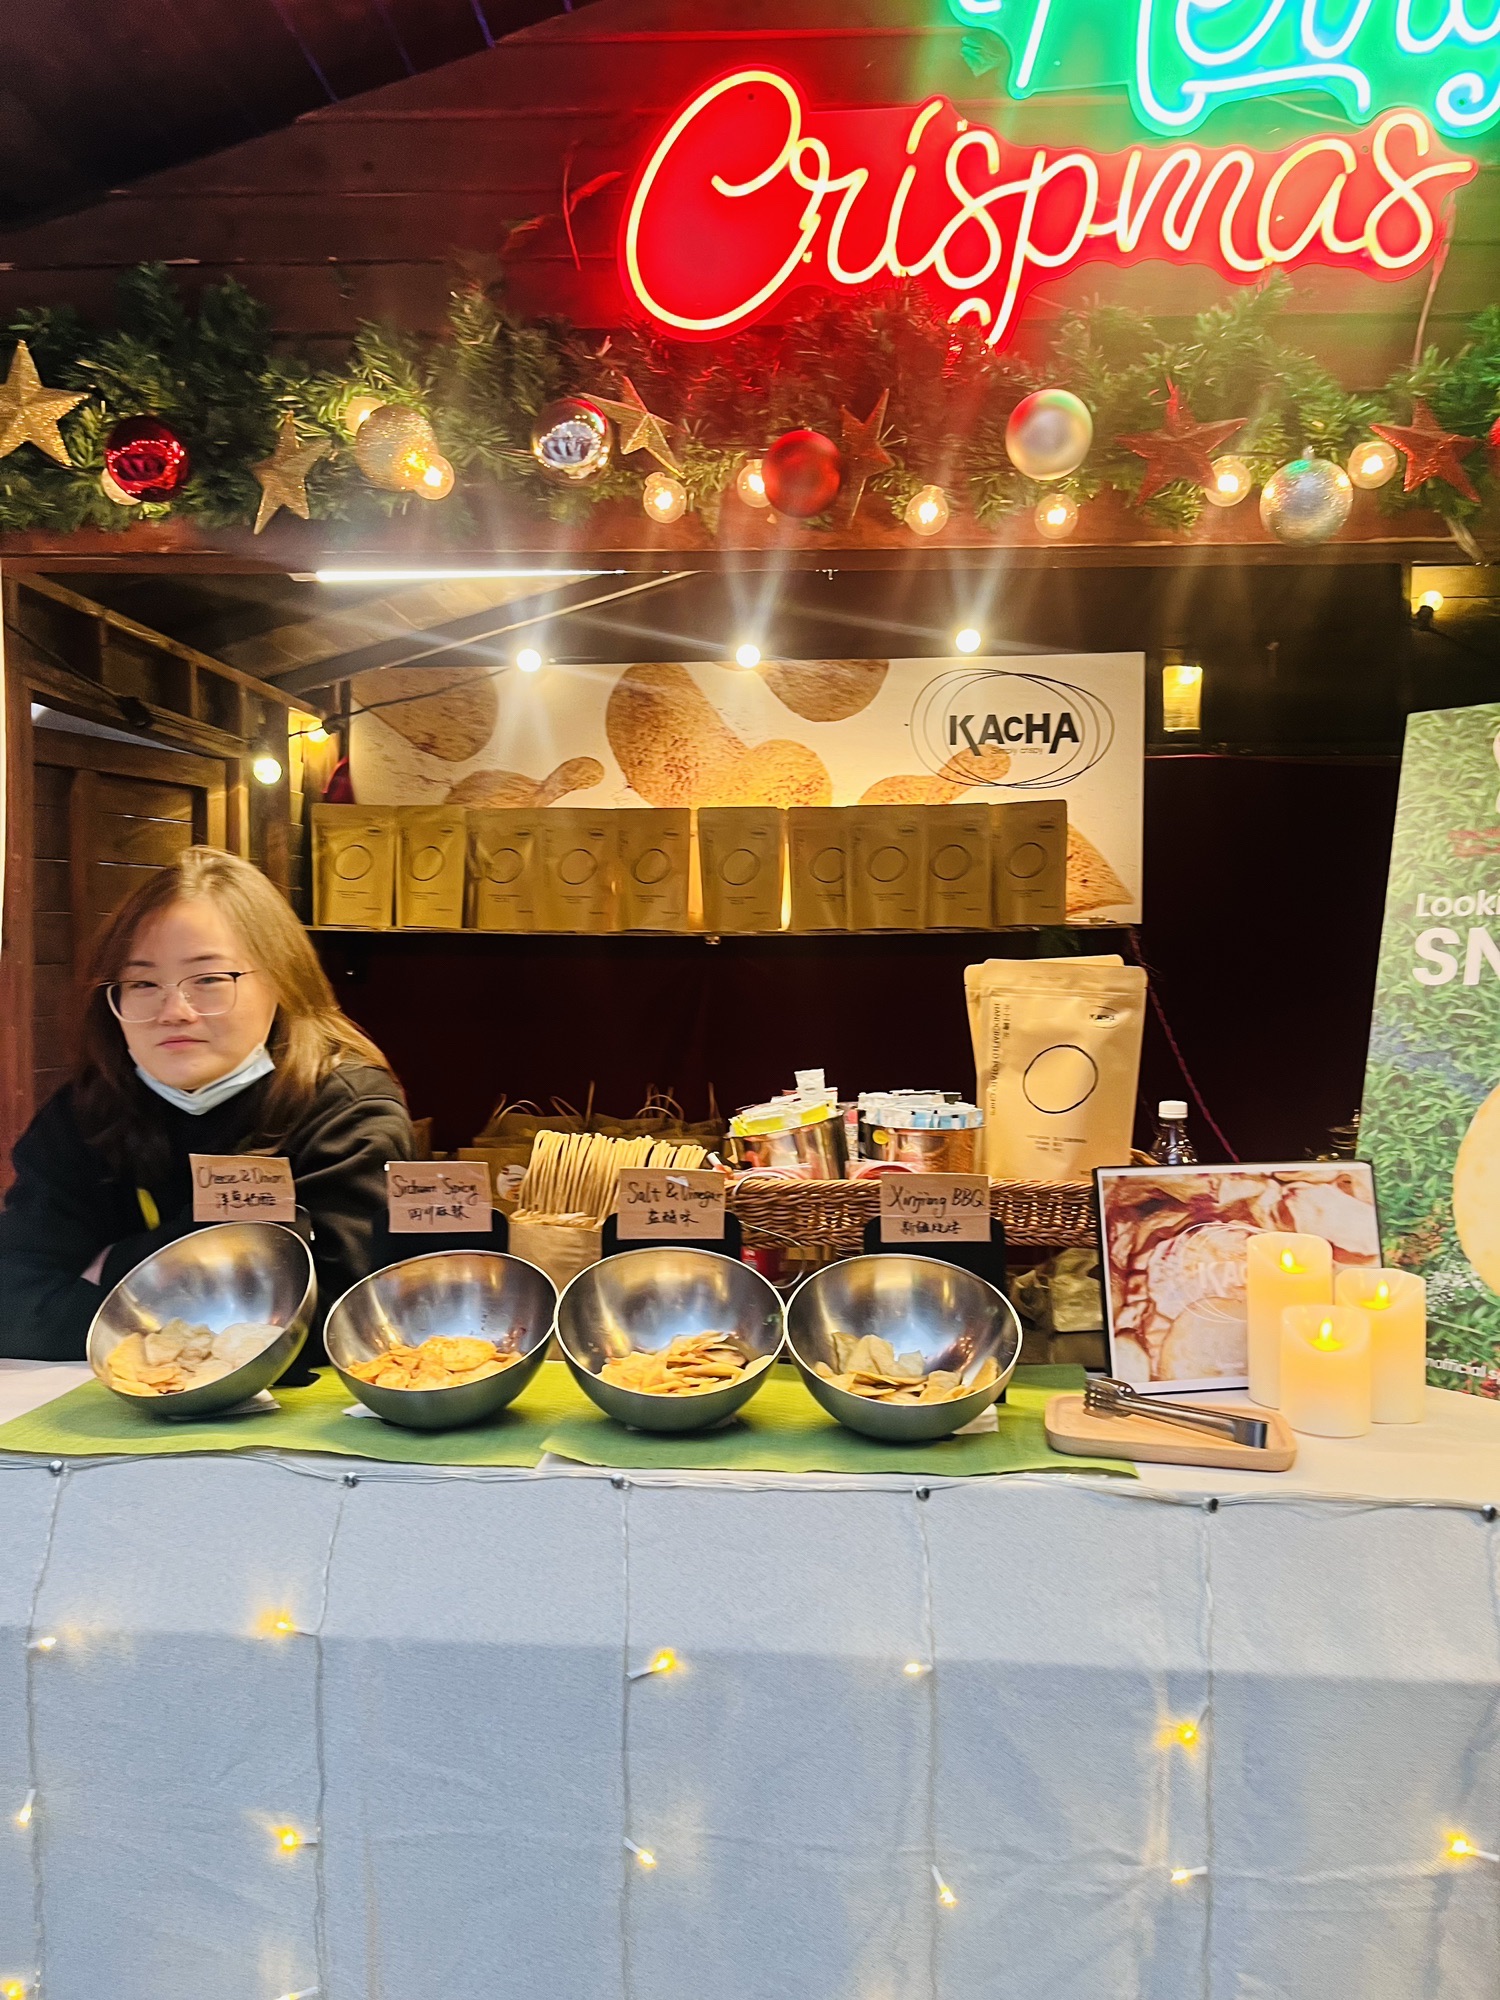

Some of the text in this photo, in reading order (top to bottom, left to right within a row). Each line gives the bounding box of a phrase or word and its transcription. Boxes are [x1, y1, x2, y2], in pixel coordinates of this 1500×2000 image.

[626, 69, 1471, 348] Crispmas
[949, 712, 1079, 757] KACHA
[627, 1181, 661, 1204] Salt
[886, 1184, 986, 1219] Xinjiang BBQ
